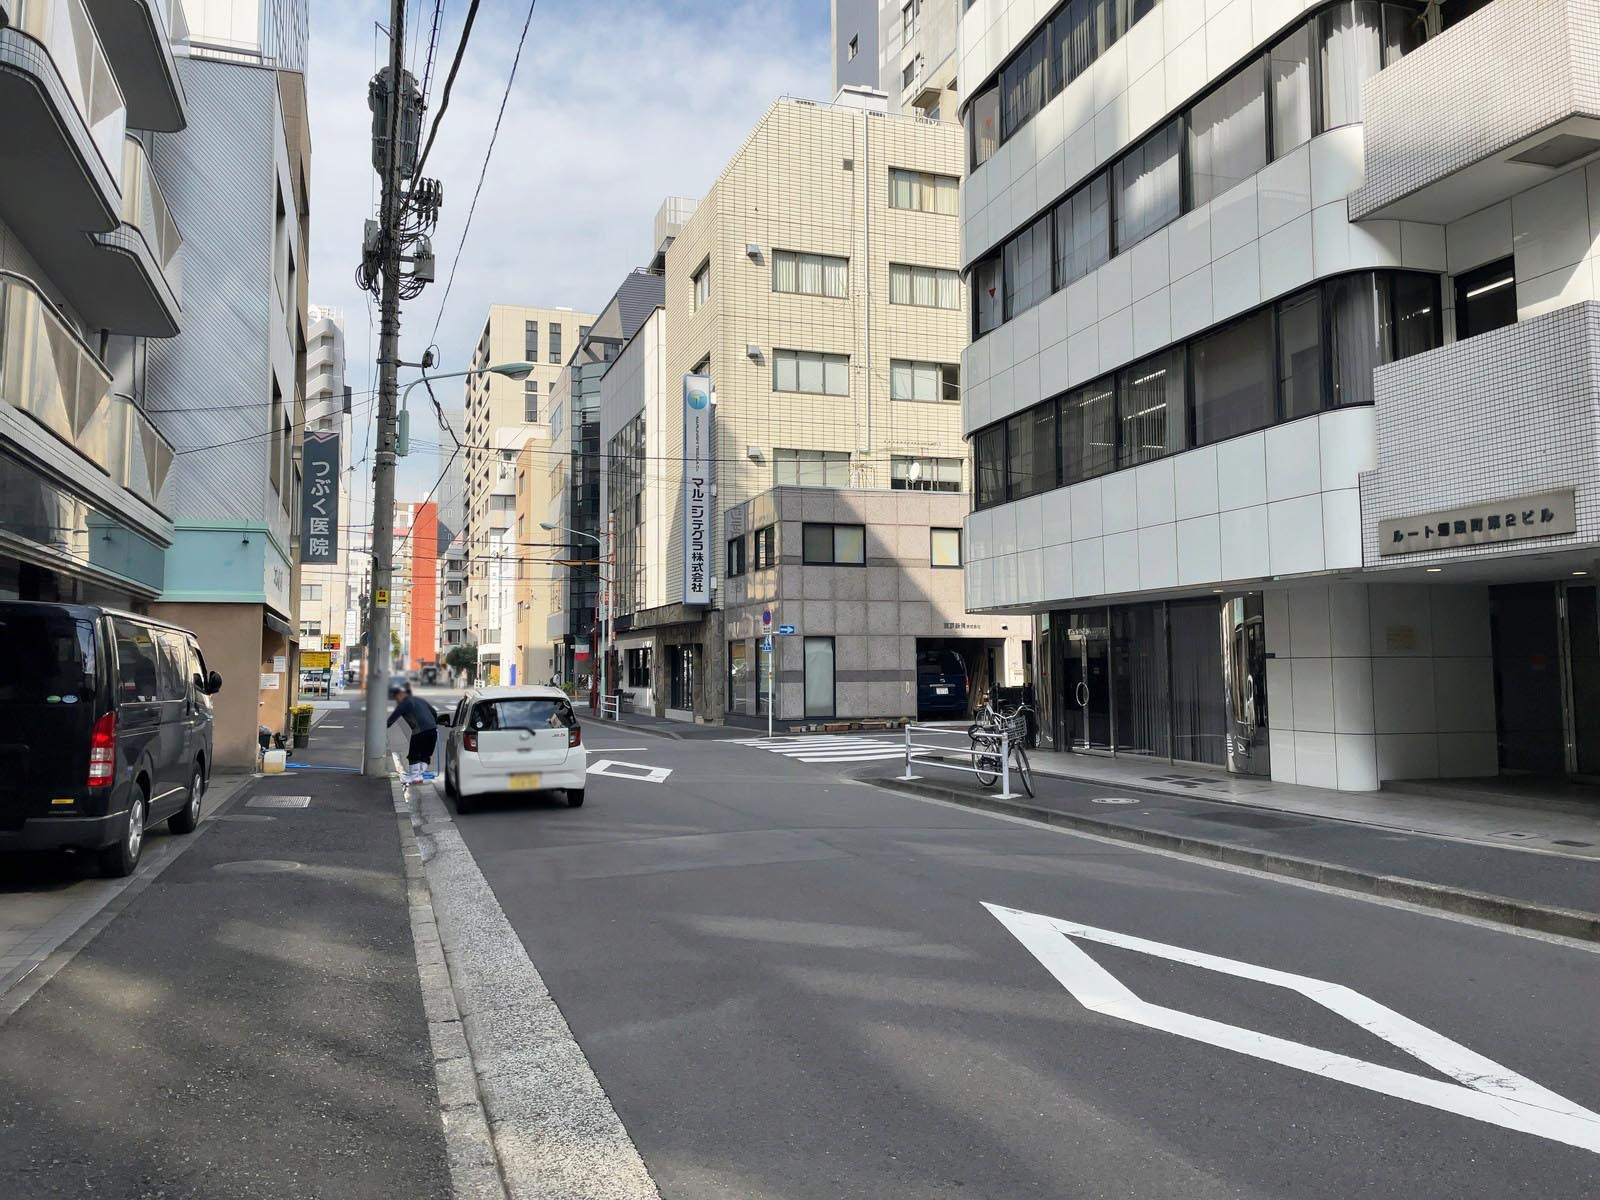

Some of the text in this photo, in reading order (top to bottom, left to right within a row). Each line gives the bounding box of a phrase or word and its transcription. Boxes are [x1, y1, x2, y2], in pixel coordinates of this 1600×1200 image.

[310, 461, 330, 556] つぶく医院
[691, 478, 704, 593] マルニシテグラ株式会社
